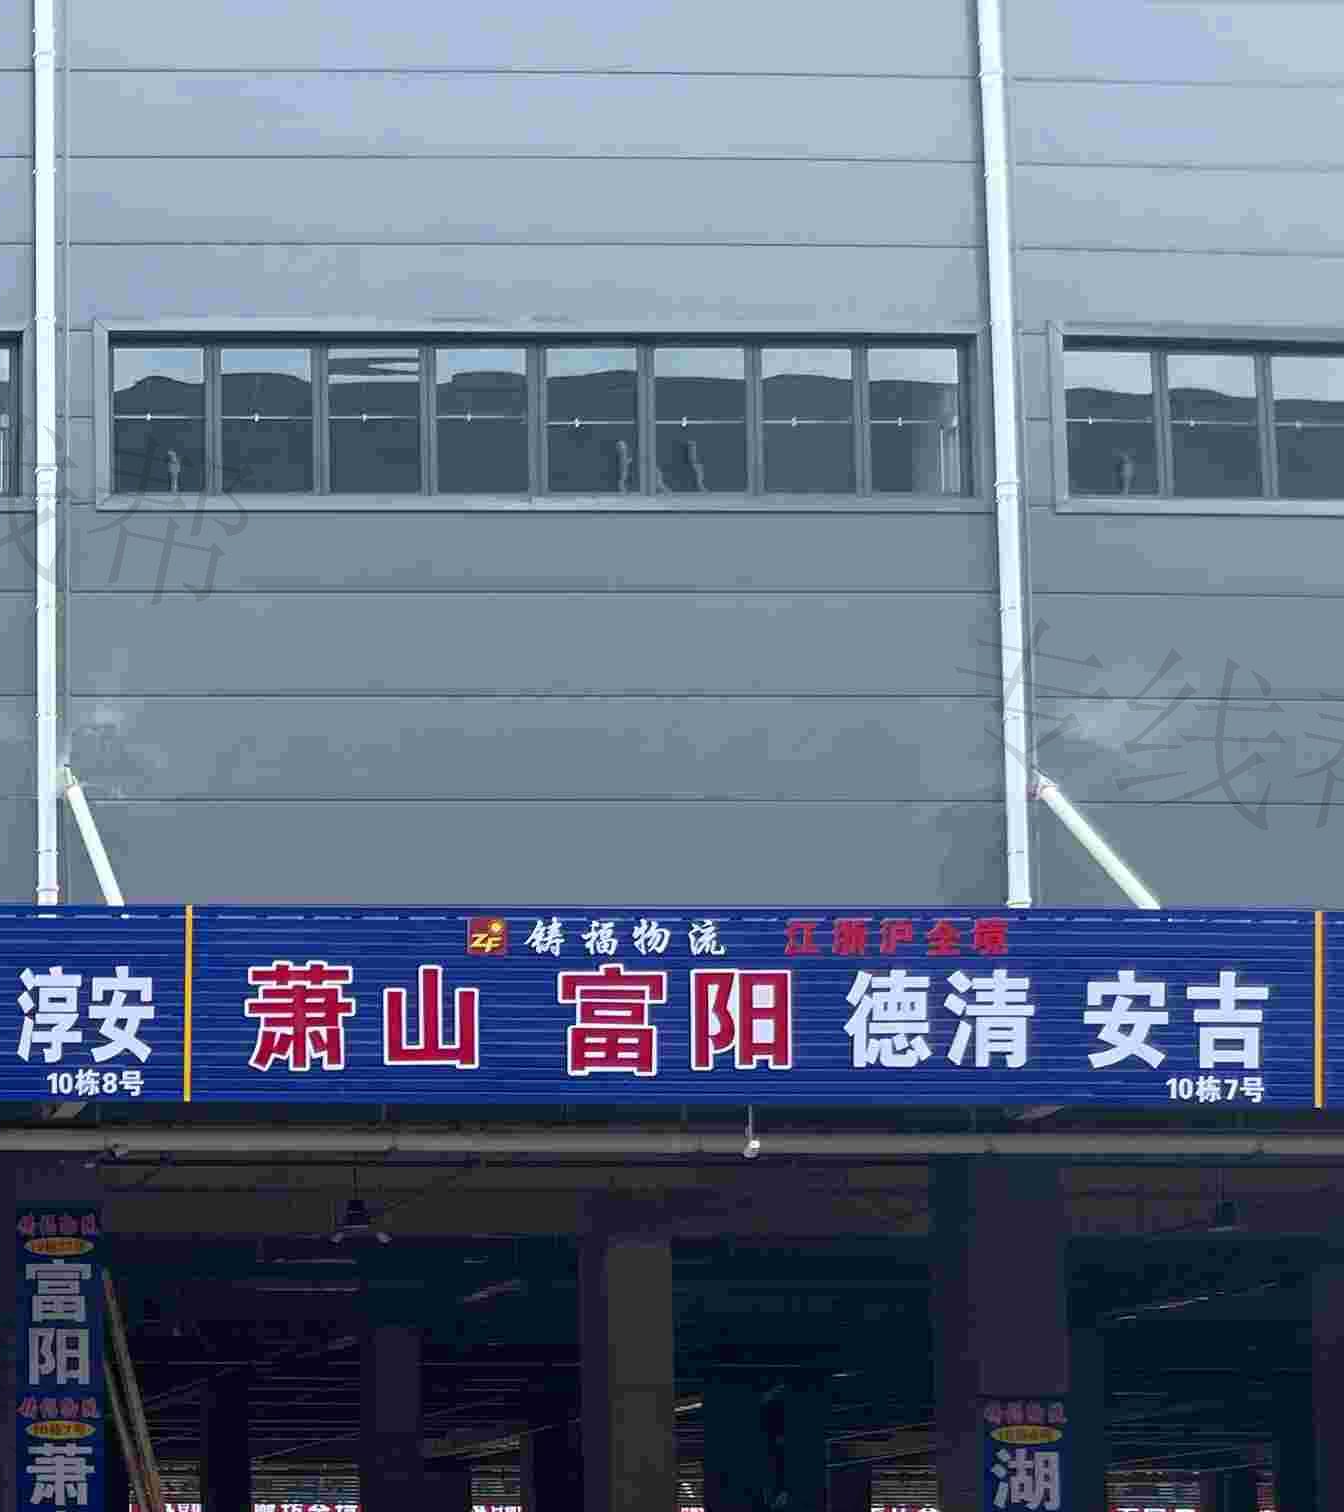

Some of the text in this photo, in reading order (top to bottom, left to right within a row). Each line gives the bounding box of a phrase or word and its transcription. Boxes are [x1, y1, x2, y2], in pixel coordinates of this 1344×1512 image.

[16, 966, 155, 1064] 淳安
[244, 960, 1269, 1077] 萧山 富阳 德清 安吉
[46, 1070, 144, 1097] 10栋8号
[1166, 1077, 1265, 1103] 10栋7号
[25, 1260, 92, 1386] 富阳
